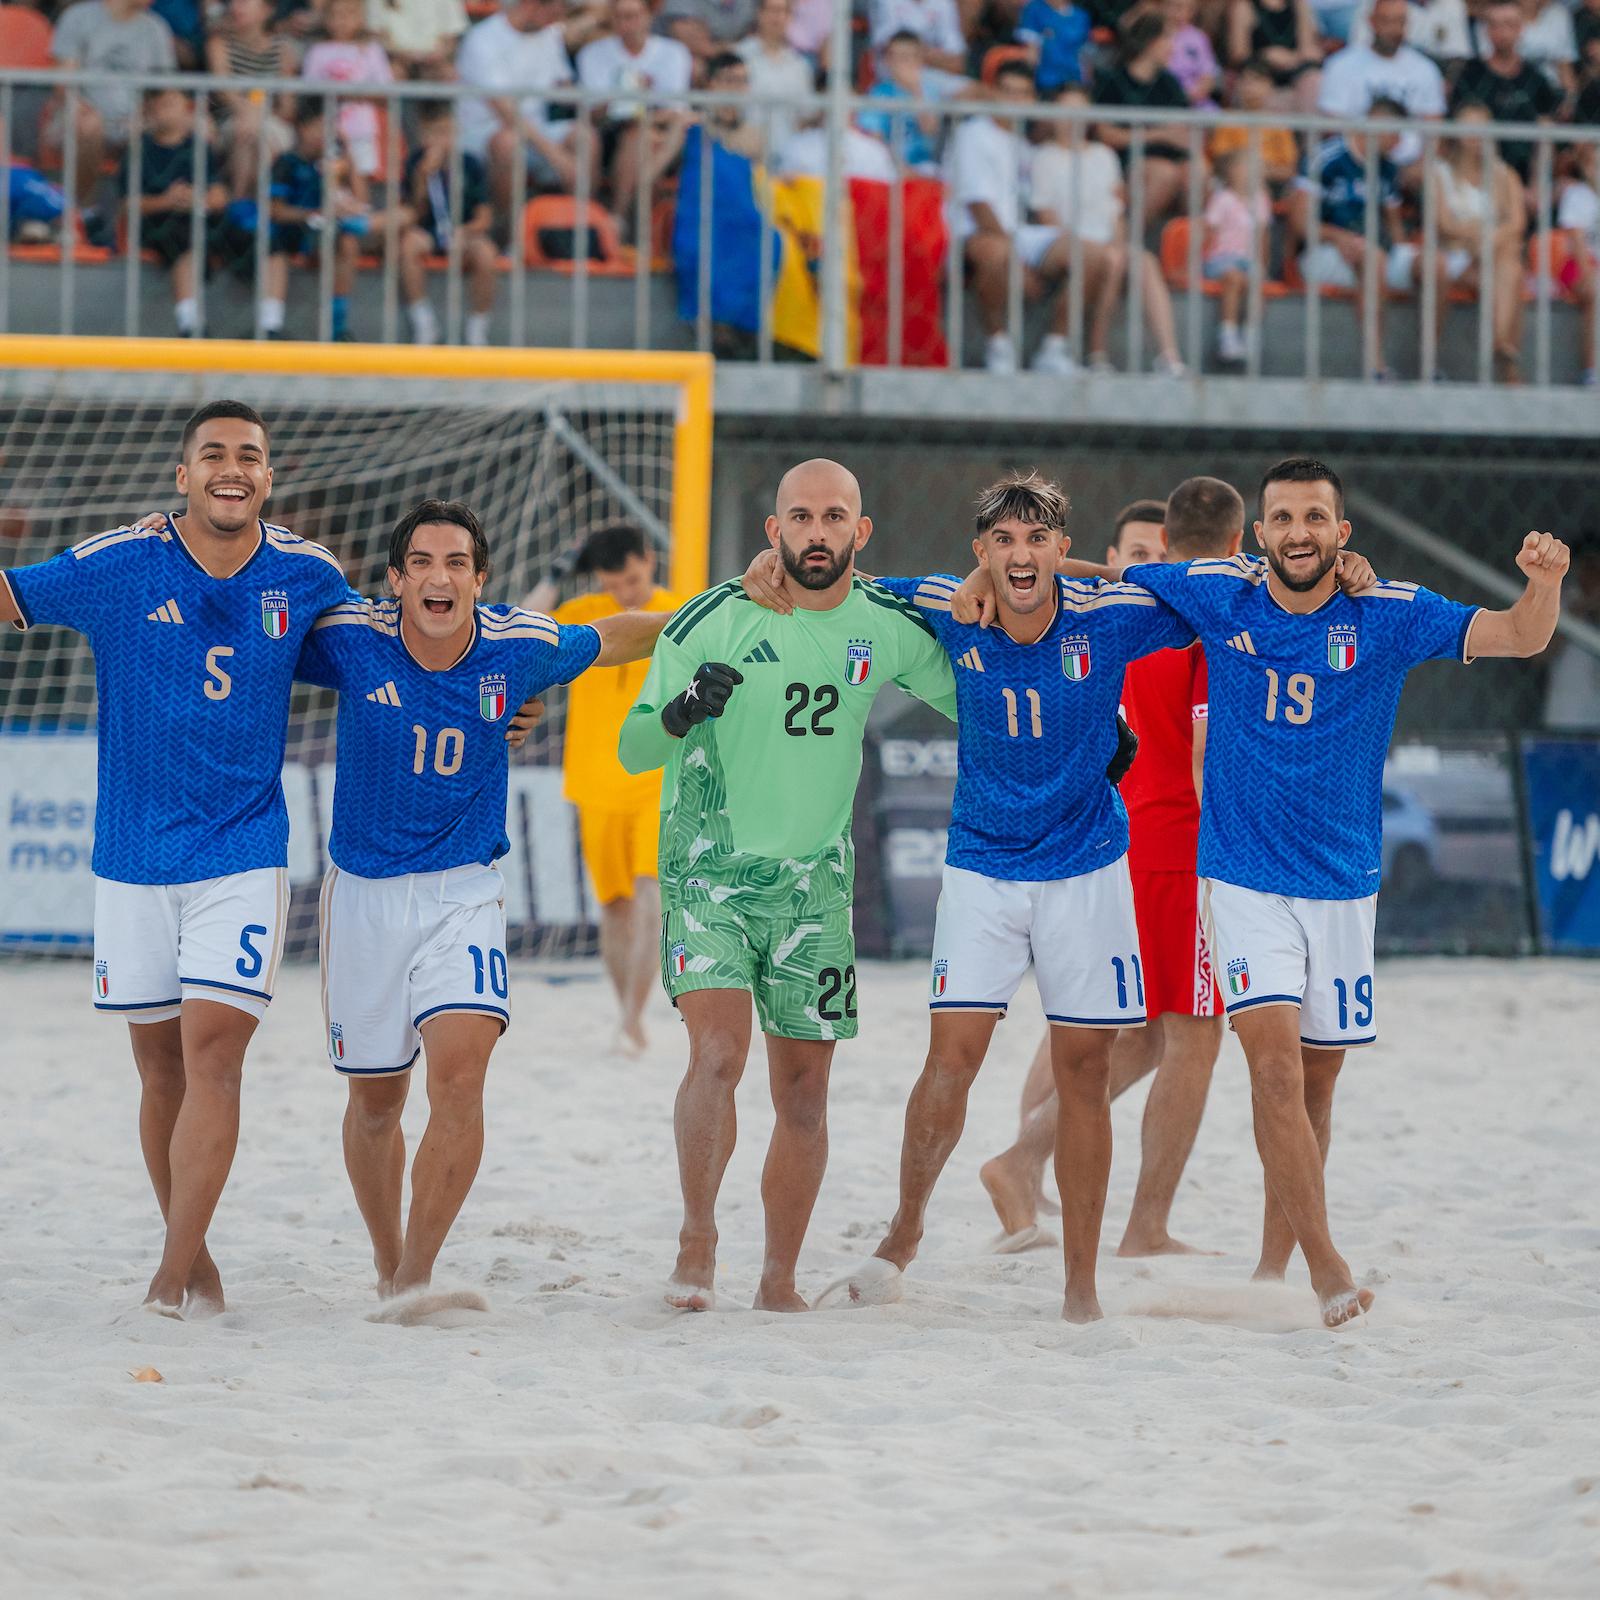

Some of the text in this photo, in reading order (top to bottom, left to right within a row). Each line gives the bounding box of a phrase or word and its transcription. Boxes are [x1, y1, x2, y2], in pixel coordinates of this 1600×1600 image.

[263, 601, 287, 609] ITALIA
[849, 648, 869, 657] ITALIA
[1063, 644, 1086, 653] ITALIA
[1329, 635, 1354, 643] ITALIA
[203, 645, 234, 701] 5
[481, 684, 504, 694] ITALIA
[1265, 668, 1315, 725] 19
[784, 682, 839, 737] 22
[1001, 687, 1042, 738] 11
[412, 724, 465, 776] 10
[9, 789, 94, 830] kee
[1551, 808, 1600, 880] W
[236, 924, 267, 978] 5
[468, 944, 508, 1000] 10
[818, 964, 857, 1020] 22
[1111, 954, 1144, 1008] 11
[1333, 974, 1372, 1030] 19
